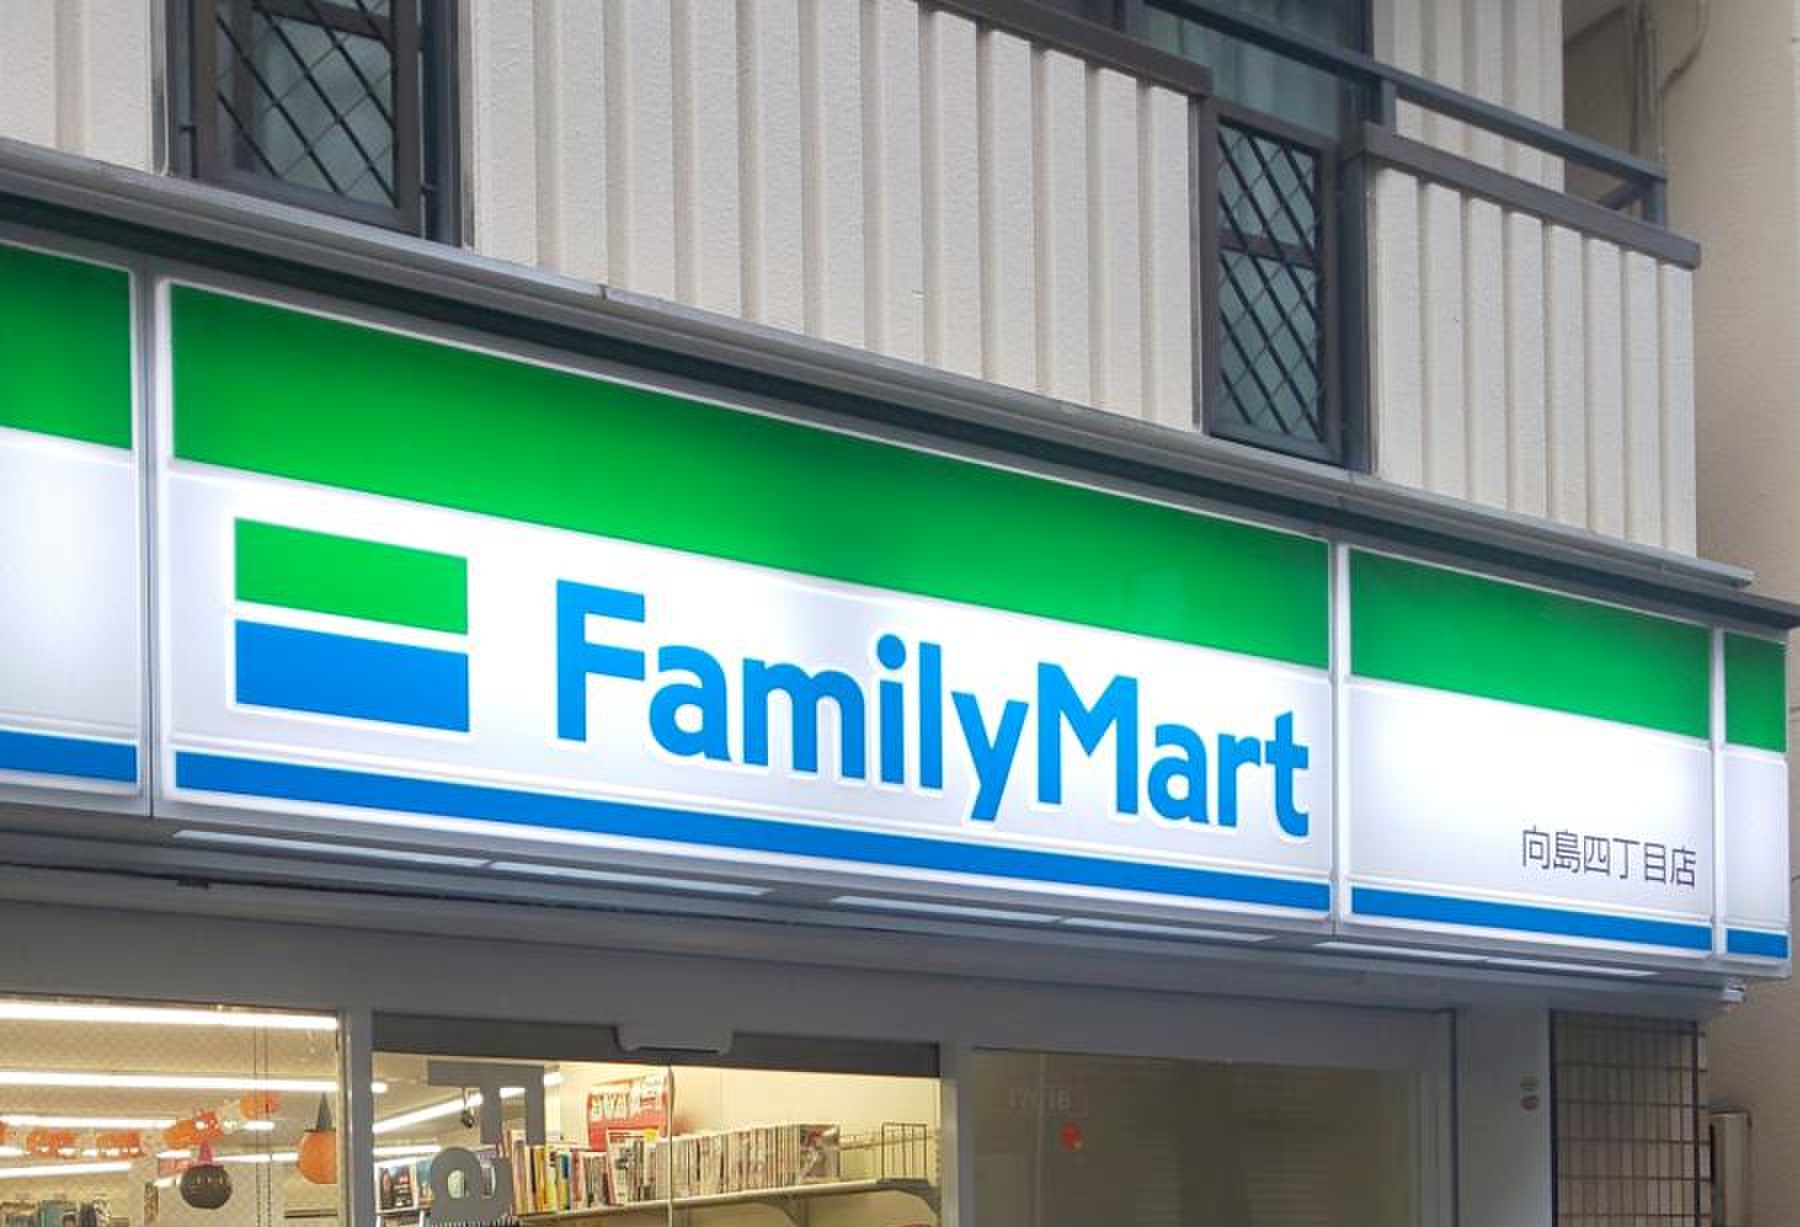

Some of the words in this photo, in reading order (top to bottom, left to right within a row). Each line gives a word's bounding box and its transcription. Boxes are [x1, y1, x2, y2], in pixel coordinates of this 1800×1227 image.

[556, 579, 1308, 838] FamilyMart
[1522, 824, 1696, 889] 向島四丁目店
